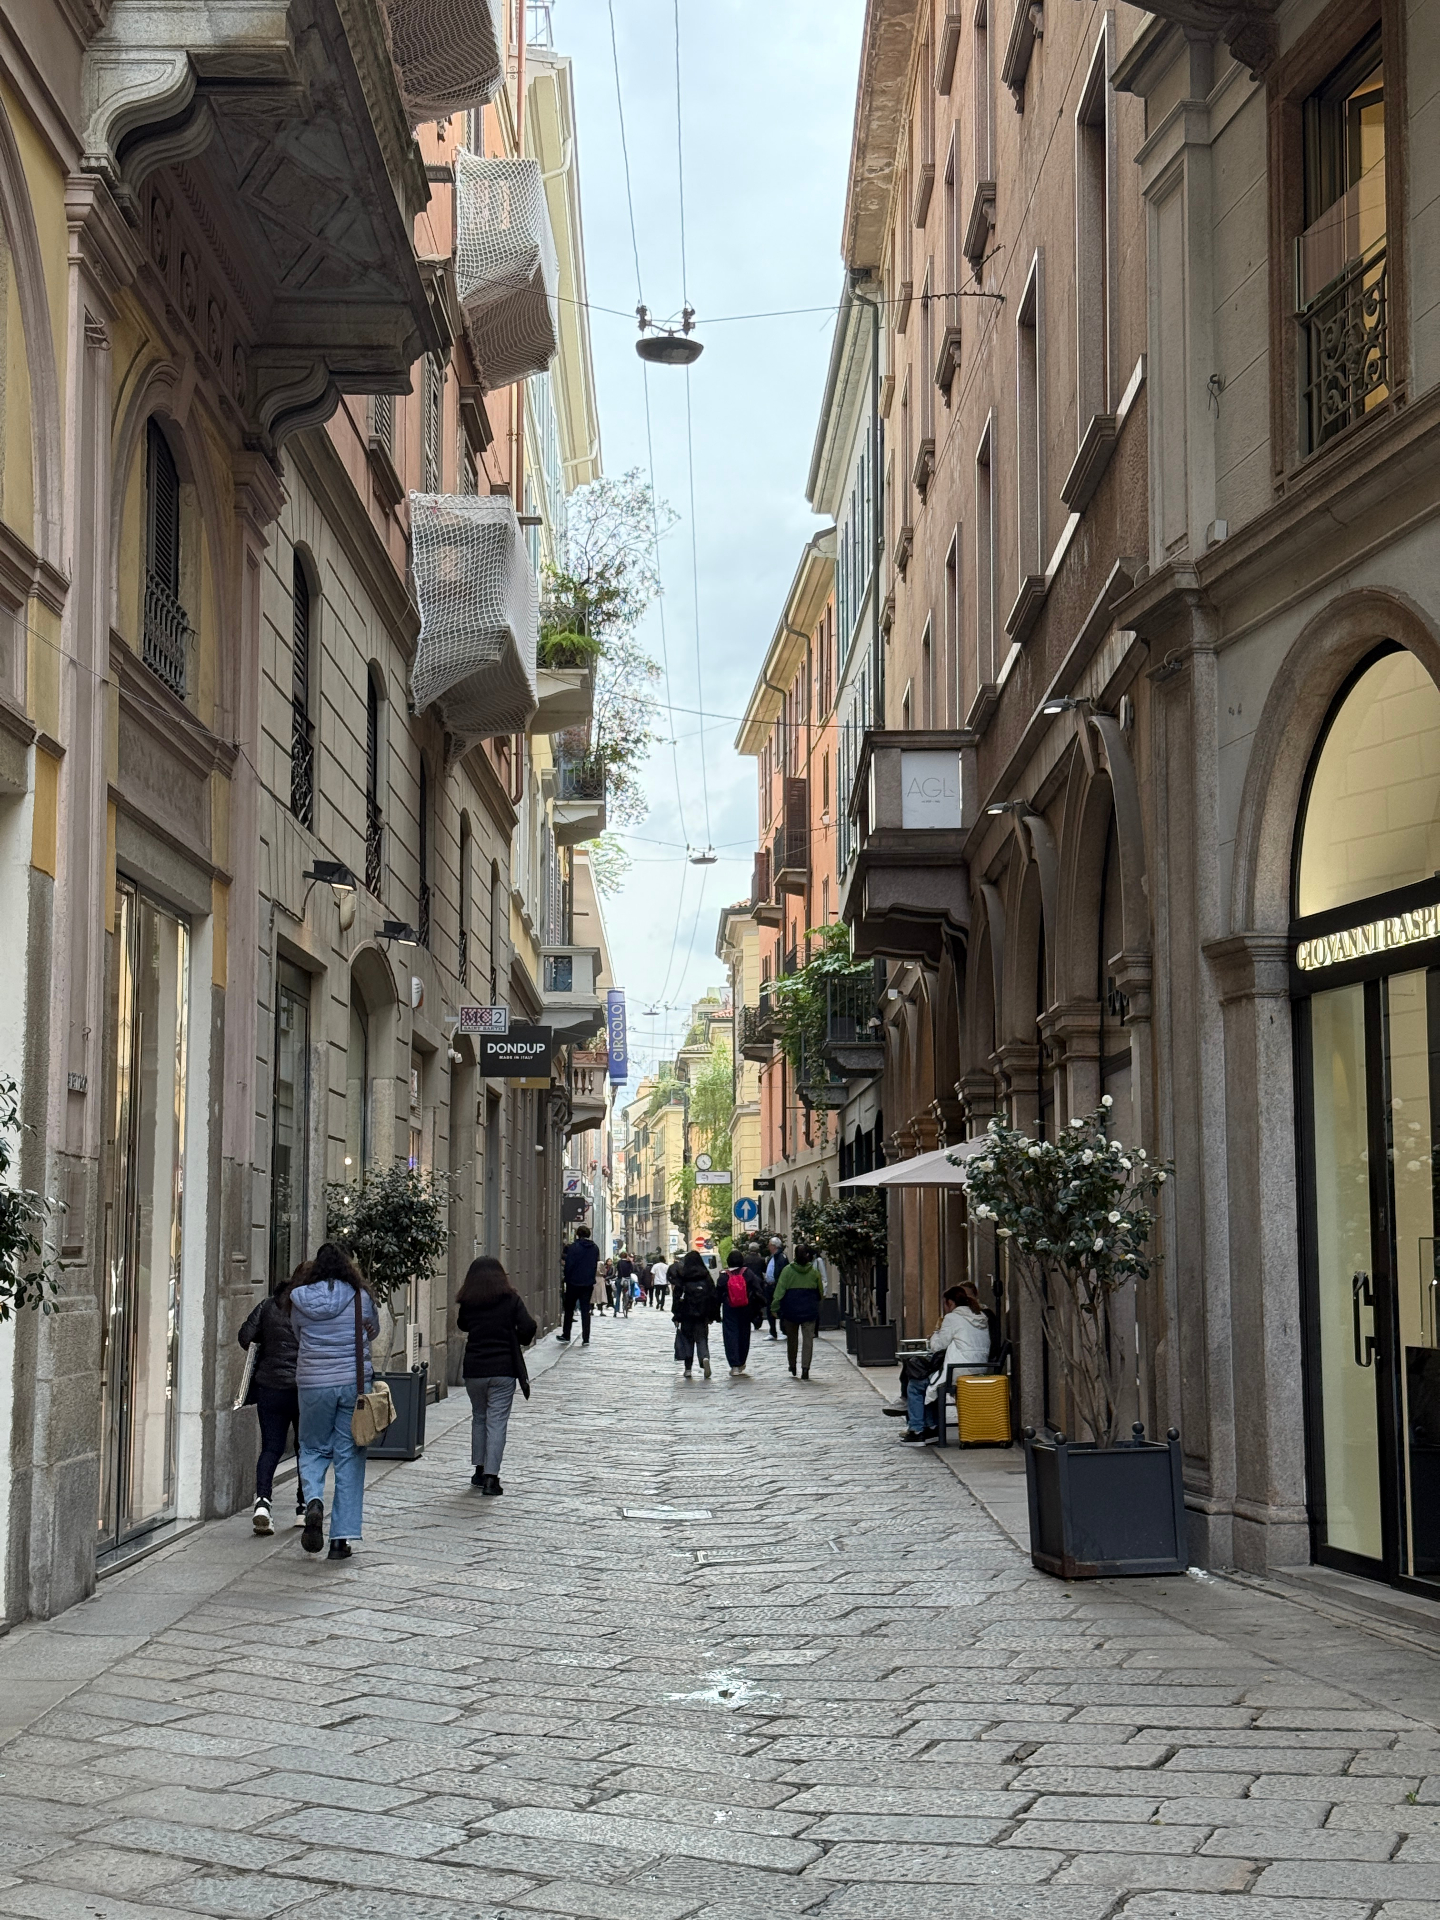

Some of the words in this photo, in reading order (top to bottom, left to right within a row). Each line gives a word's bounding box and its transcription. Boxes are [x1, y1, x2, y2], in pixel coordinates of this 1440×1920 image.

[906, 777, 955, 798] AGL
[1296, 919, 1382, 971] GIOVANNI
[487, 1042, 546, 1054] DONDUP
[611, 1004, 624, 1062] CIRCOLO
